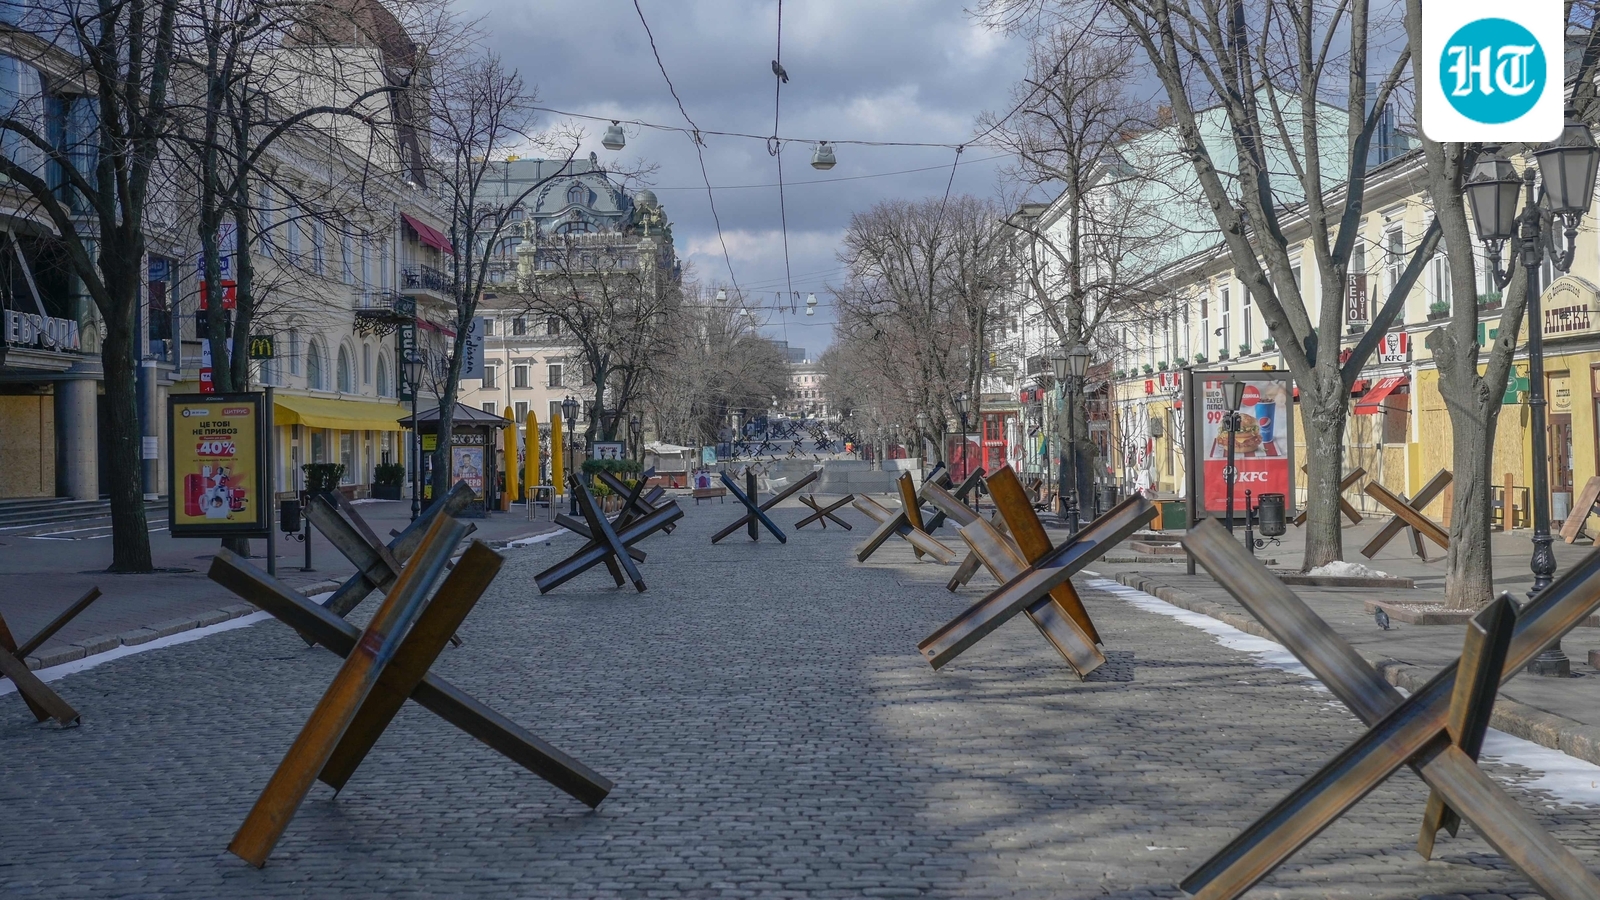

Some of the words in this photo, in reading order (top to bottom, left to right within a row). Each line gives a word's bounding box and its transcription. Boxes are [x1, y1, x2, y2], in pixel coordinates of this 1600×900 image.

[1349, 274, 1358, 320] RENO
[4, 309, 81, 350] ЕВРОПА
[1544, 304, 1590, 334] АПТЕКА
[1384, 354, 1403, 362] KFC
[1206, 411, 1221, 424] 99
[1239, 471, 1268, 483] KFC
